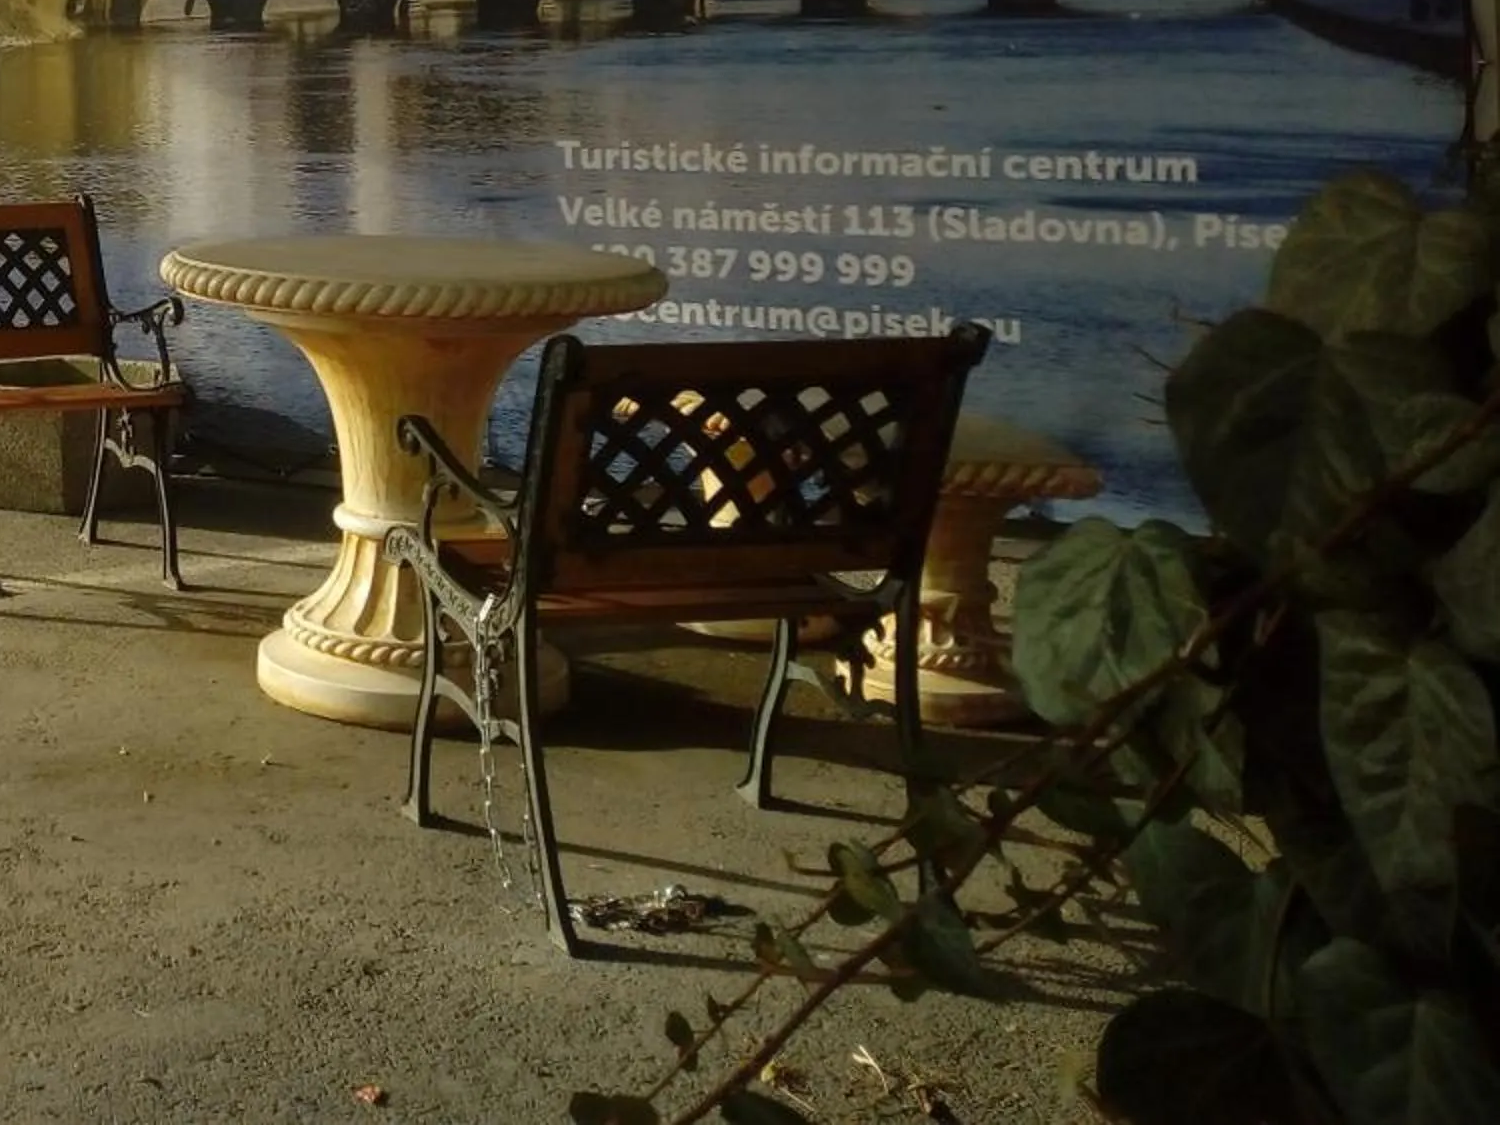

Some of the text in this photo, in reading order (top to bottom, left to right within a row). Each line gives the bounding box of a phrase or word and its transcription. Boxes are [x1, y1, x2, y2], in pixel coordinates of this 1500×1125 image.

[556, 139, 1198, 184] Turistické informační centrum
[558, 196, 1301, 250] Velké náměstí 113 (Sladovna), Píse
[668, 246, 739, 278] 387
[749, 249, 825, 283] 999
[837, 254, 916, 287] 999
